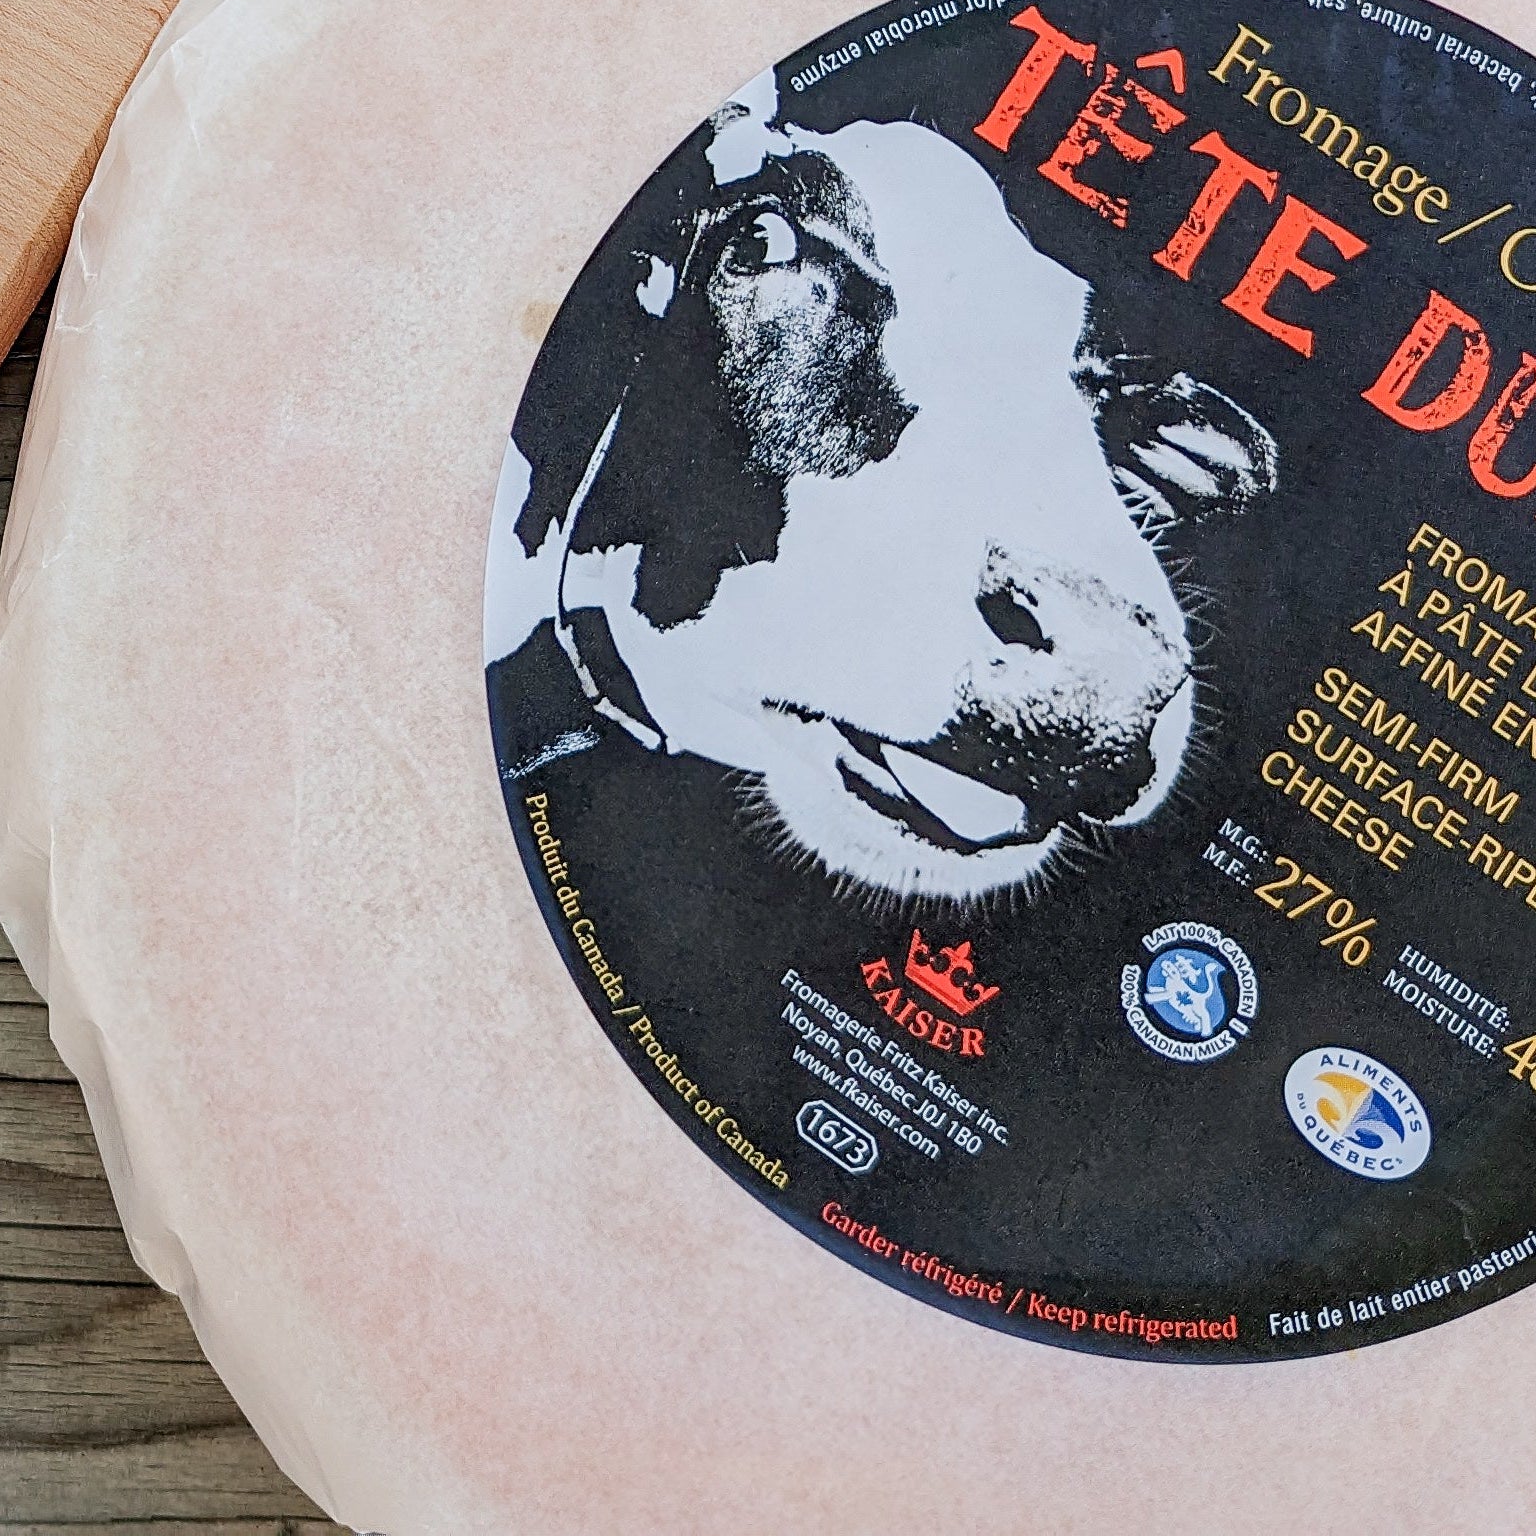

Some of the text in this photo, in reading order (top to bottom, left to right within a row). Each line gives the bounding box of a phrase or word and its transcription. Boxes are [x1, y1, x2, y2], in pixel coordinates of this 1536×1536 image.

[790, 40, 862, 93] enzyme
[864, 0, 957, 54] microbial
[1435, 32, 1522, 93] bacterial
[1207, 22, 1449, 224] Fromage
[972, 5, 1369, 360] TÊTE
[1350, 609, 1497, 718] AFFINÉ
[1378, 559, 1524, 678] À PÂTE
[1314, 667, 1521, 824] SEMI-FIRM
[1261, 751, 1415, 870] CHEESE
[1253, 855, 1377, 966] 27%
[526, 792, 568, 883] Produit
[555, 882, 581, 920] du
[572, 918, 626, 1004] Canada
[629, 1014, 699, 1102] Product
[694, 1097, 725, 1127] of
[716, 1117, 791, 1190] Canada
[860, 956, 985, 1057] KAISER
[1145, 924, 1254, 1015] LAIT 100% CANADIEN
[1383, 969, 1497, 1059] MOISTURE:
[1398, 944, 1510, 1033] HUMIDITÉ:
[780, 968, 1009, 1145] Fromagerie Fritz Kaiser inc.
[780, 1001, 841, 1059] Noyan,
[845, 1048, 915, 1112] Québec
[1129, 1009, 1194, 1058] CANADIAN
[1197, 1033, 1233, 1057] MILK
[792, 1043, 940, 1160] www.fkaiser.com
[804, 1109, 869, 1164] 1673
[1297, 1092, 1307, 1110] DU
[1320, 1053, 1422, 1133] ALIMENTS
[821, 1200, 899, 1258] Garder
[901, 1249, 1004, 1304] réfrigéré
[1027, 1293, 1087, 1332] Keep
[1093, 1310, 1239, 1343] refrigerated
[1268, 1312, 1312, 1337] Fait
[1317, 1306, 1344, 1330] de
[1348, 1295, 1387, 1323] lait
[1391, 1274, 1452, 1311] entier
